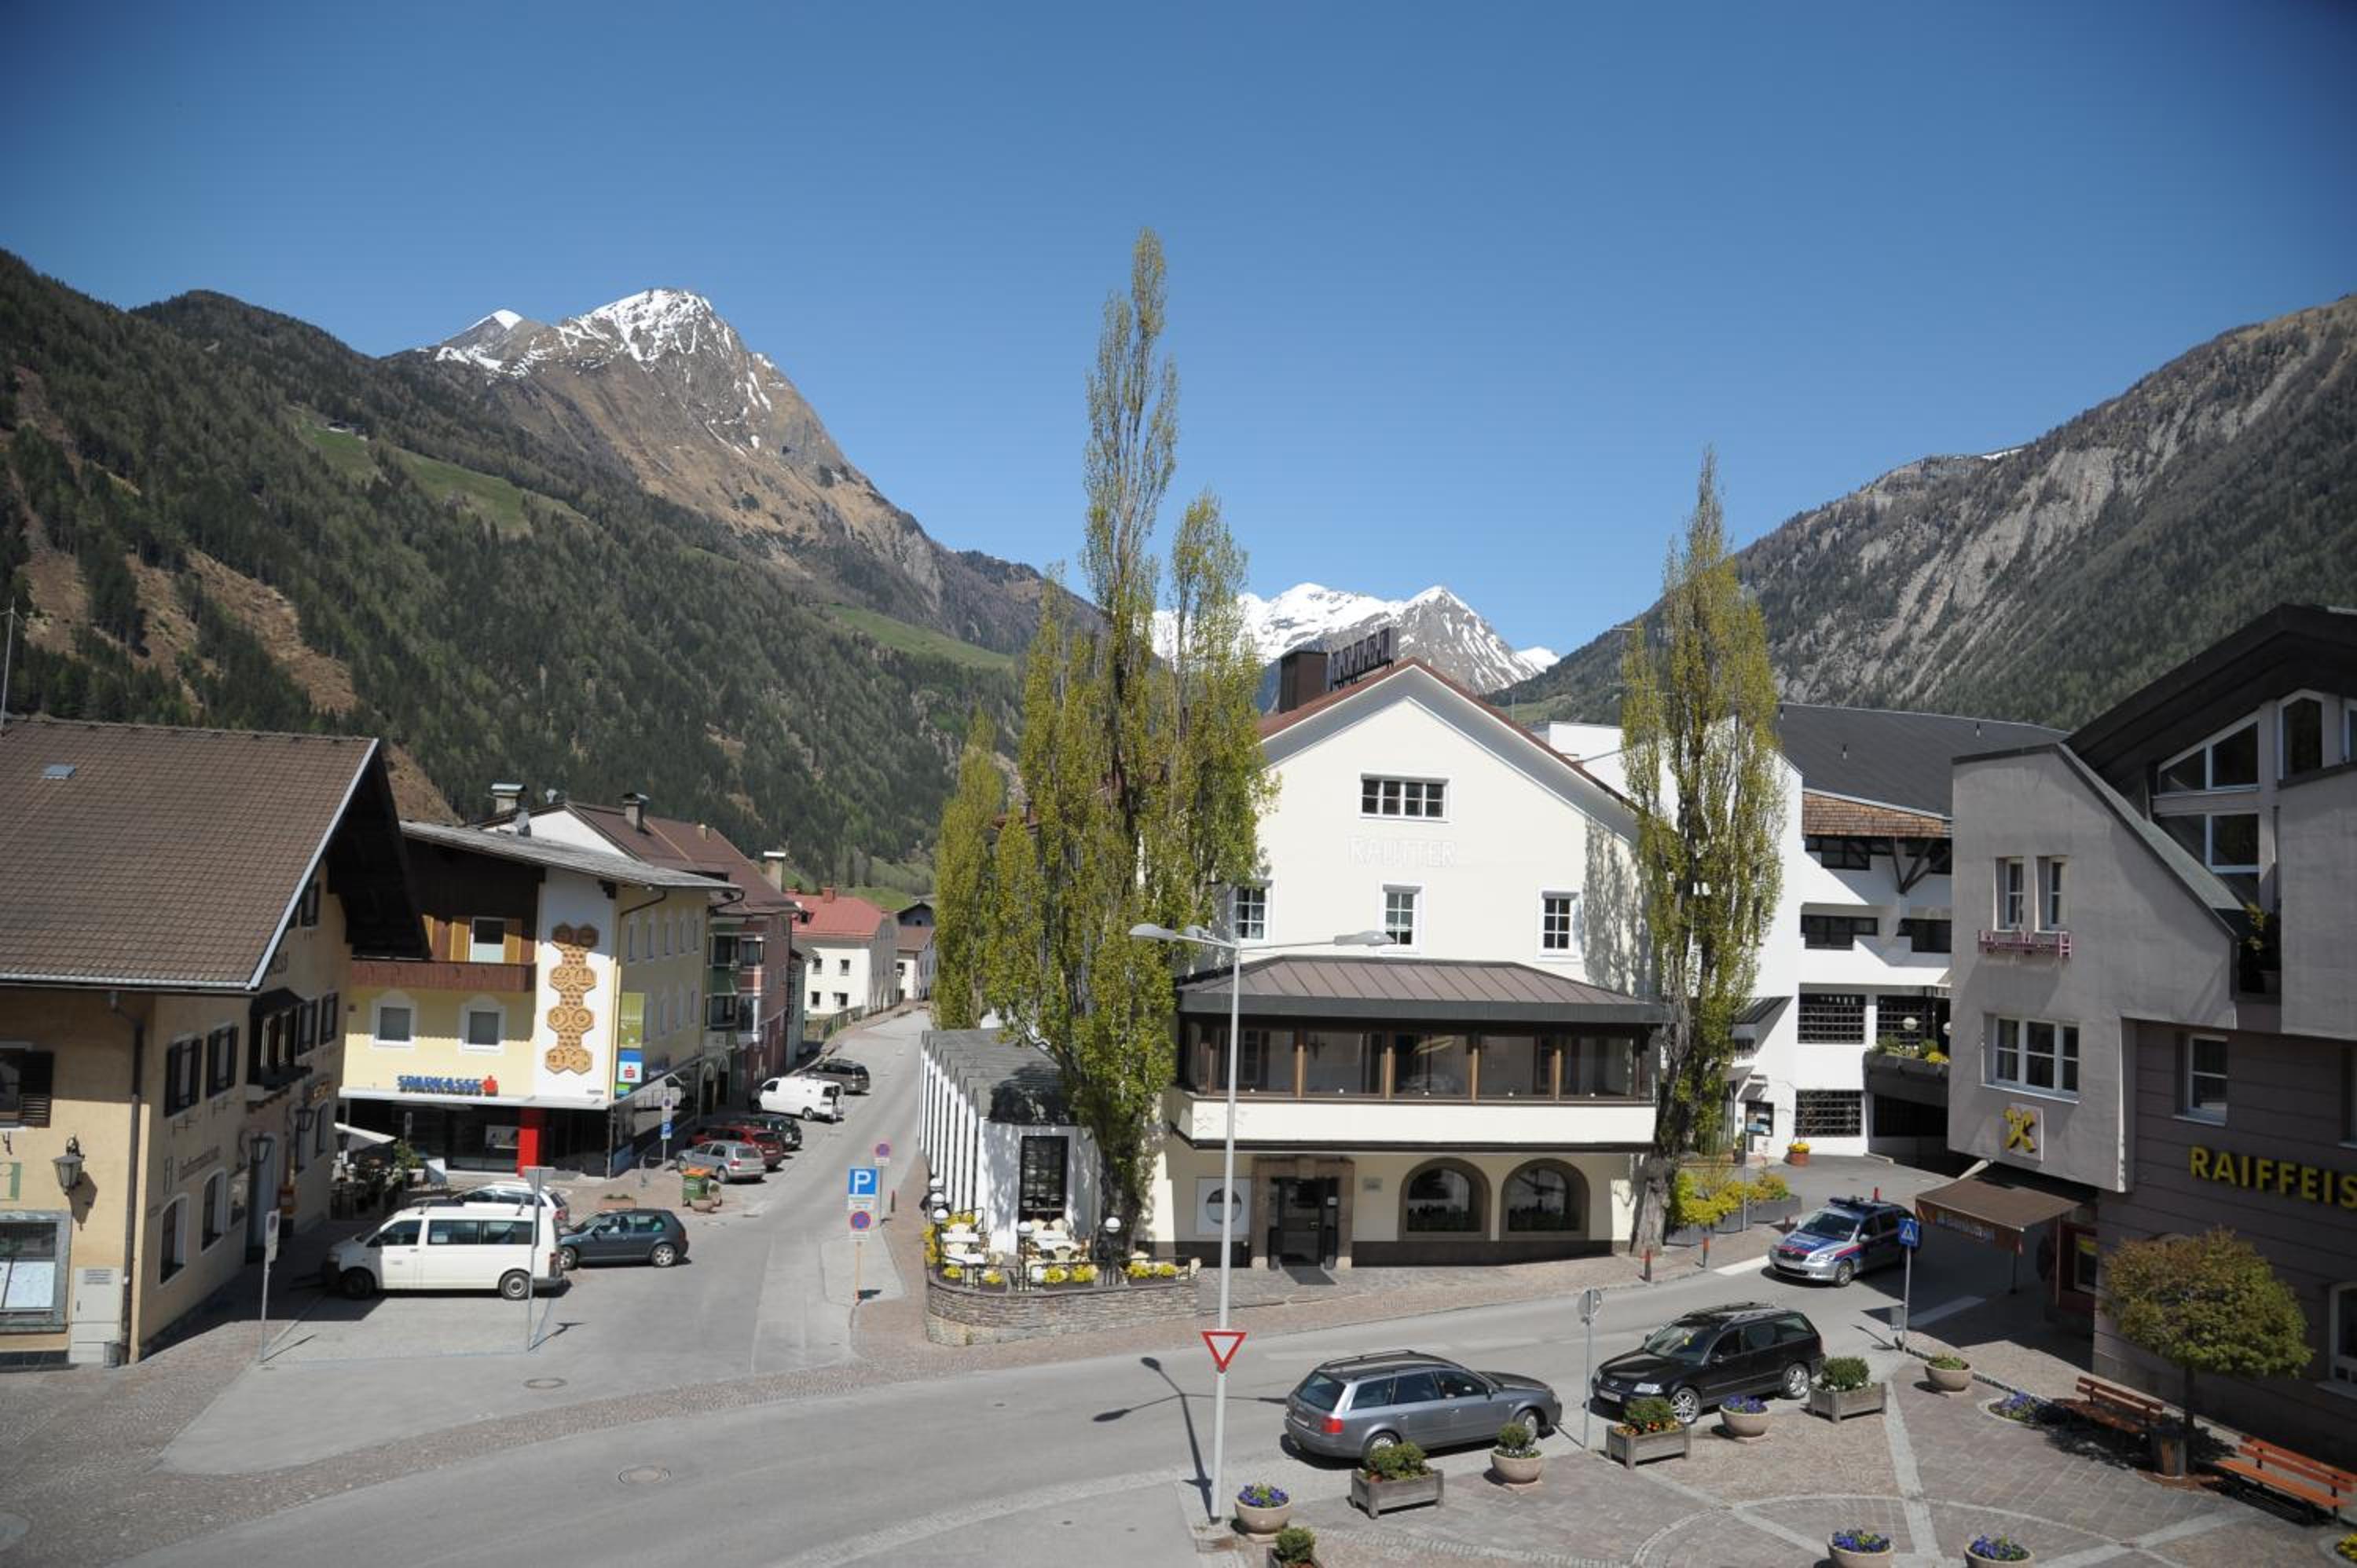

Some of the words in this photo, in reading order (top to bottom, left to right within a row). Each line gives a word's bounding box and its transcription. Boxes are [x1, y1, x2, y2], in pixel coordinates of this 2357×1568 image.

[398, 1075, 482, 1093] SPARKASSE
[854, 1170, 871, 1194] P
[2189, 1145, 2357, 1208] RAIFFEIS
